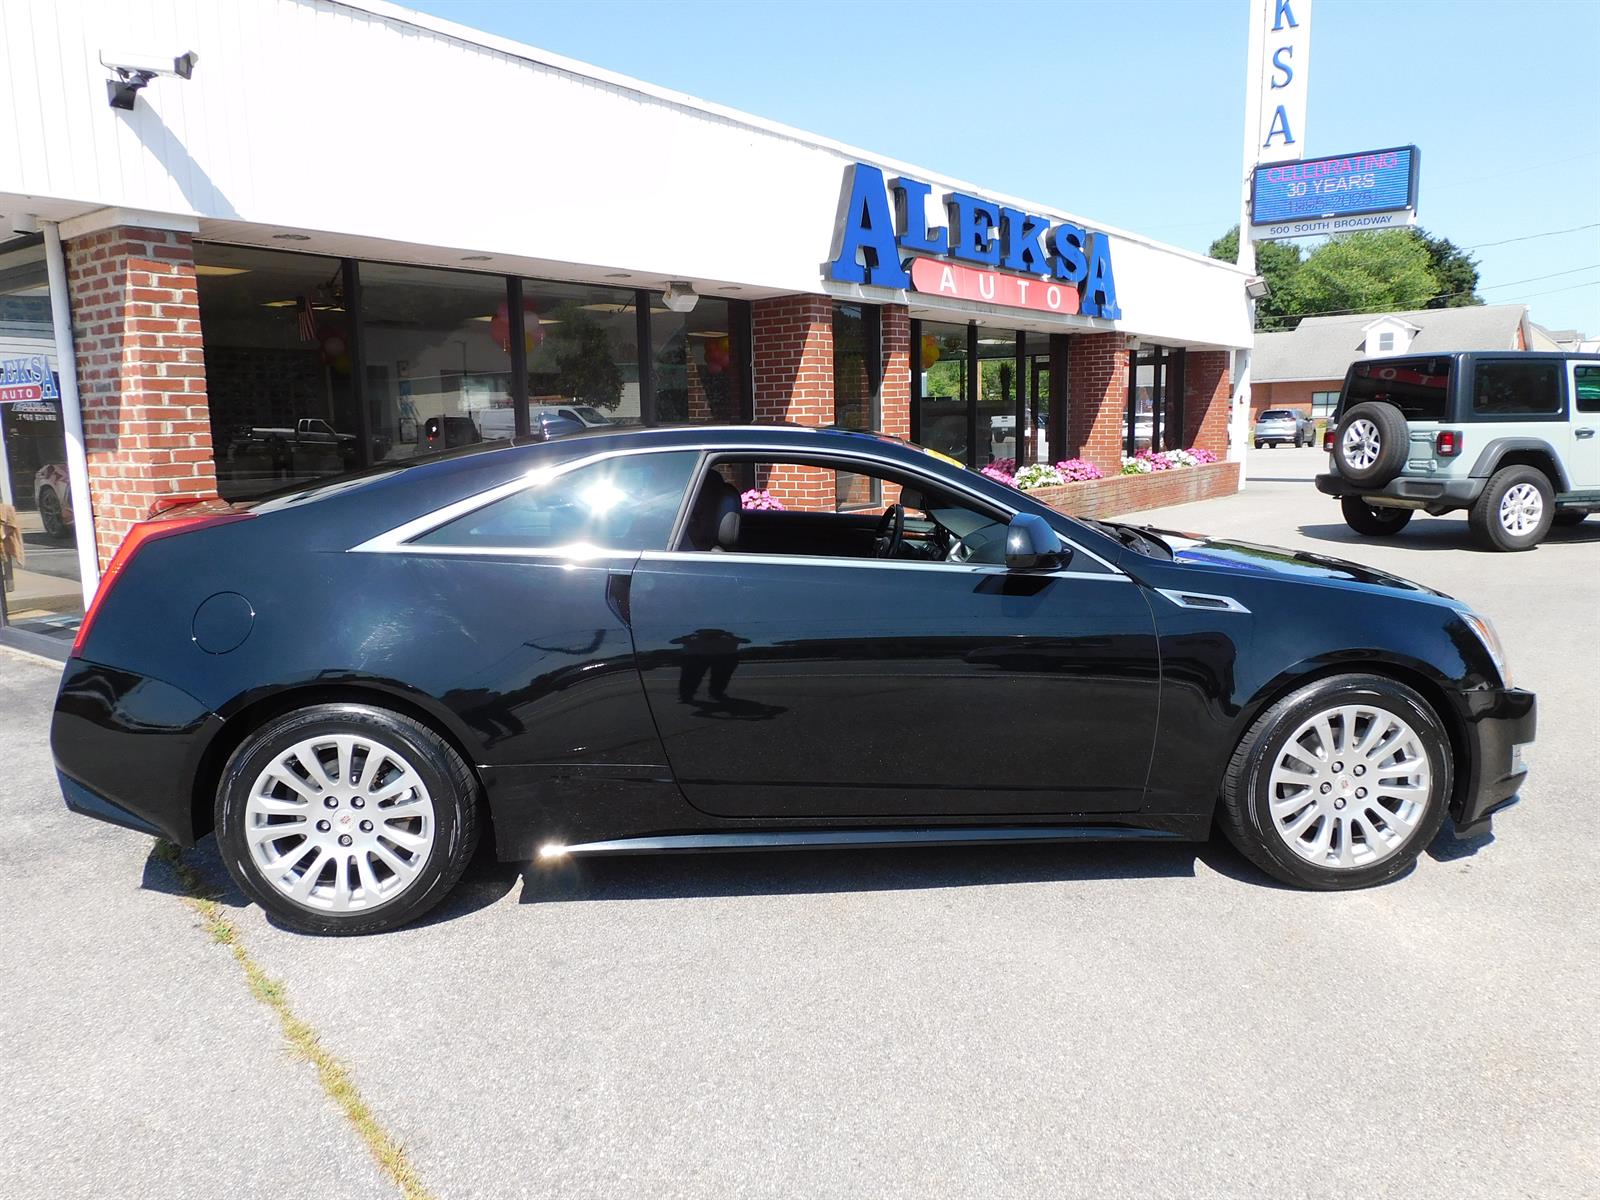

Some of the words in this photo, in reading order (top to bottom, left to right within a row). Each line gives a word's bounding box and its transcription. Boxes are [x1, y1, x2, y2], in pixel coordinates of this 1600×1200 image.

[1267, 152, 1399, 183] CELEBRATING
[1287, 182, 1306, 197] 30
[1313, 173, 1376, 193] YEARS
[1270, 226, 1289, 235] 500
[1294, 222, 1329, 232] SOUTH
[1334, 216, 1393, 228] BROADWAY
[821, 162, 1122, 320] ALEKSA
[939, 267, 1061, 309] AUTO
[2, 388, 33, 399] AUTO
